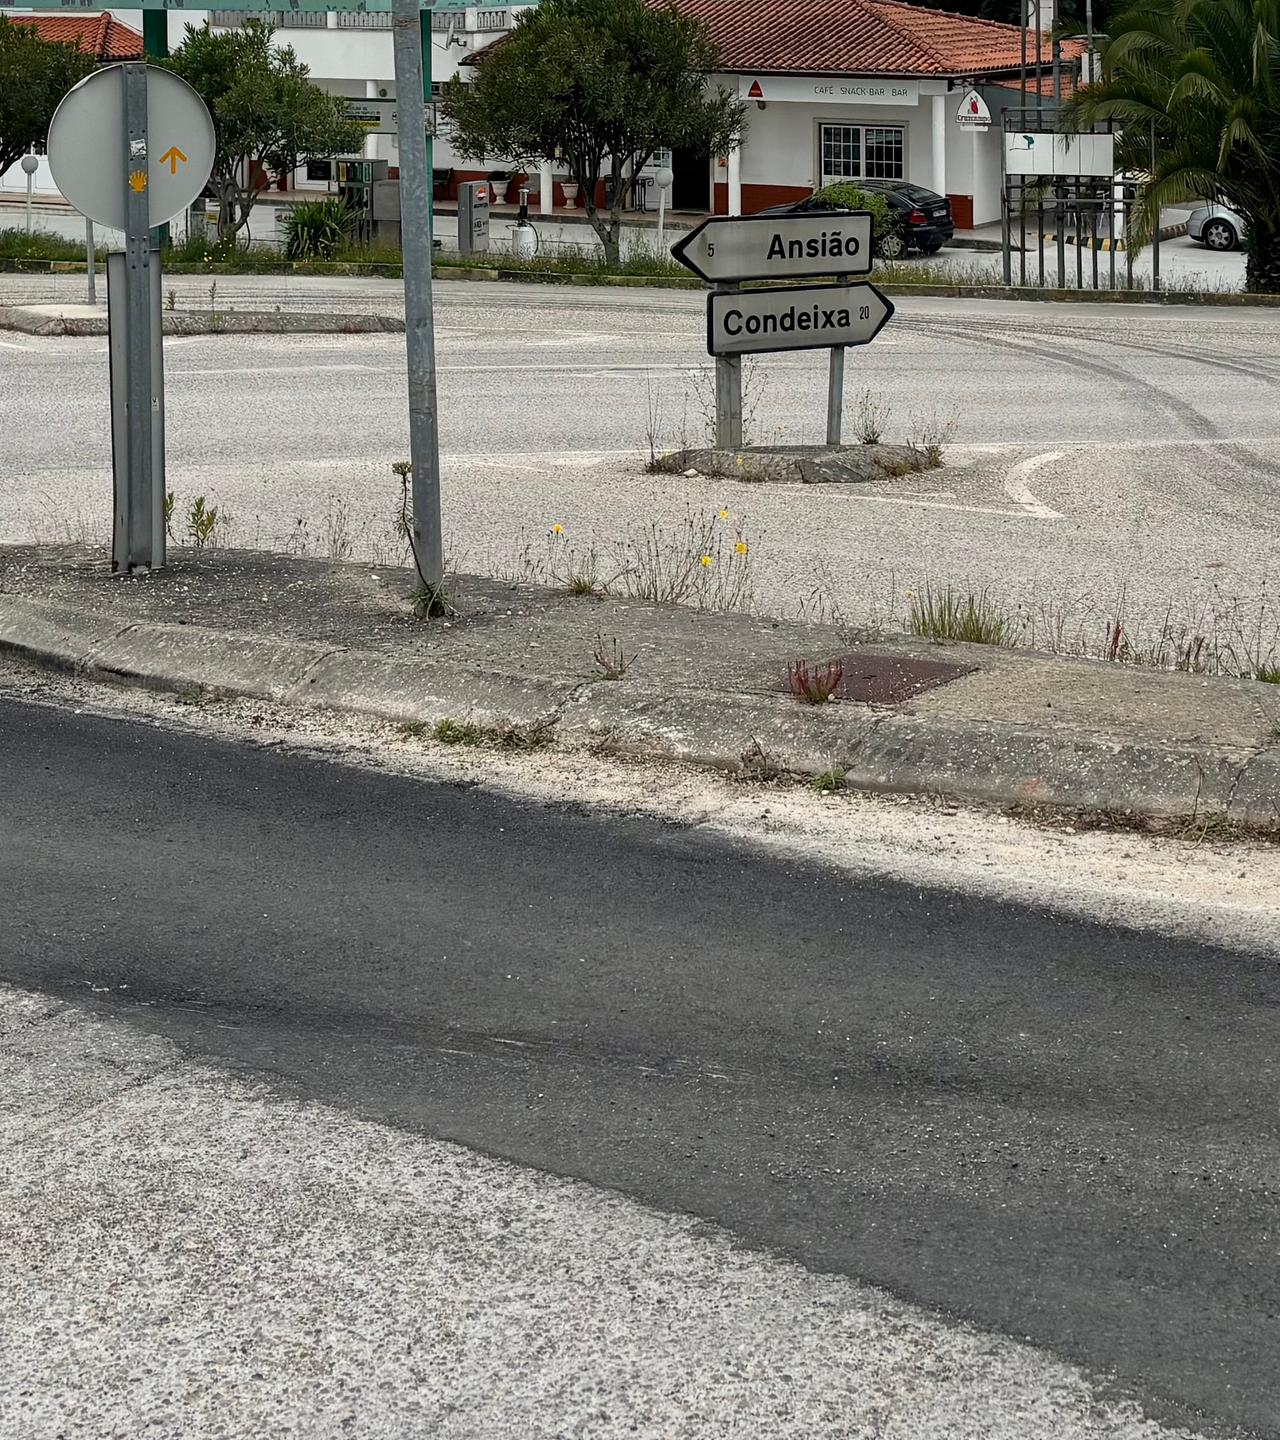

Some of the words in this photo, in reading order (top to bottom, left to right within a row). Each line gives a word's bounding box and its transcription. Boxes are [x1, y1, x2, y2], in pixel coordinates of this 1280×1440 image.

[891, 88, 908, 97] BAR
[707, 243, 715, 258] 5
[767, 231, 860, 260] Ansião
[723, 305, 851, 336] Condeixa
[859, 305, 870, 321] 20
